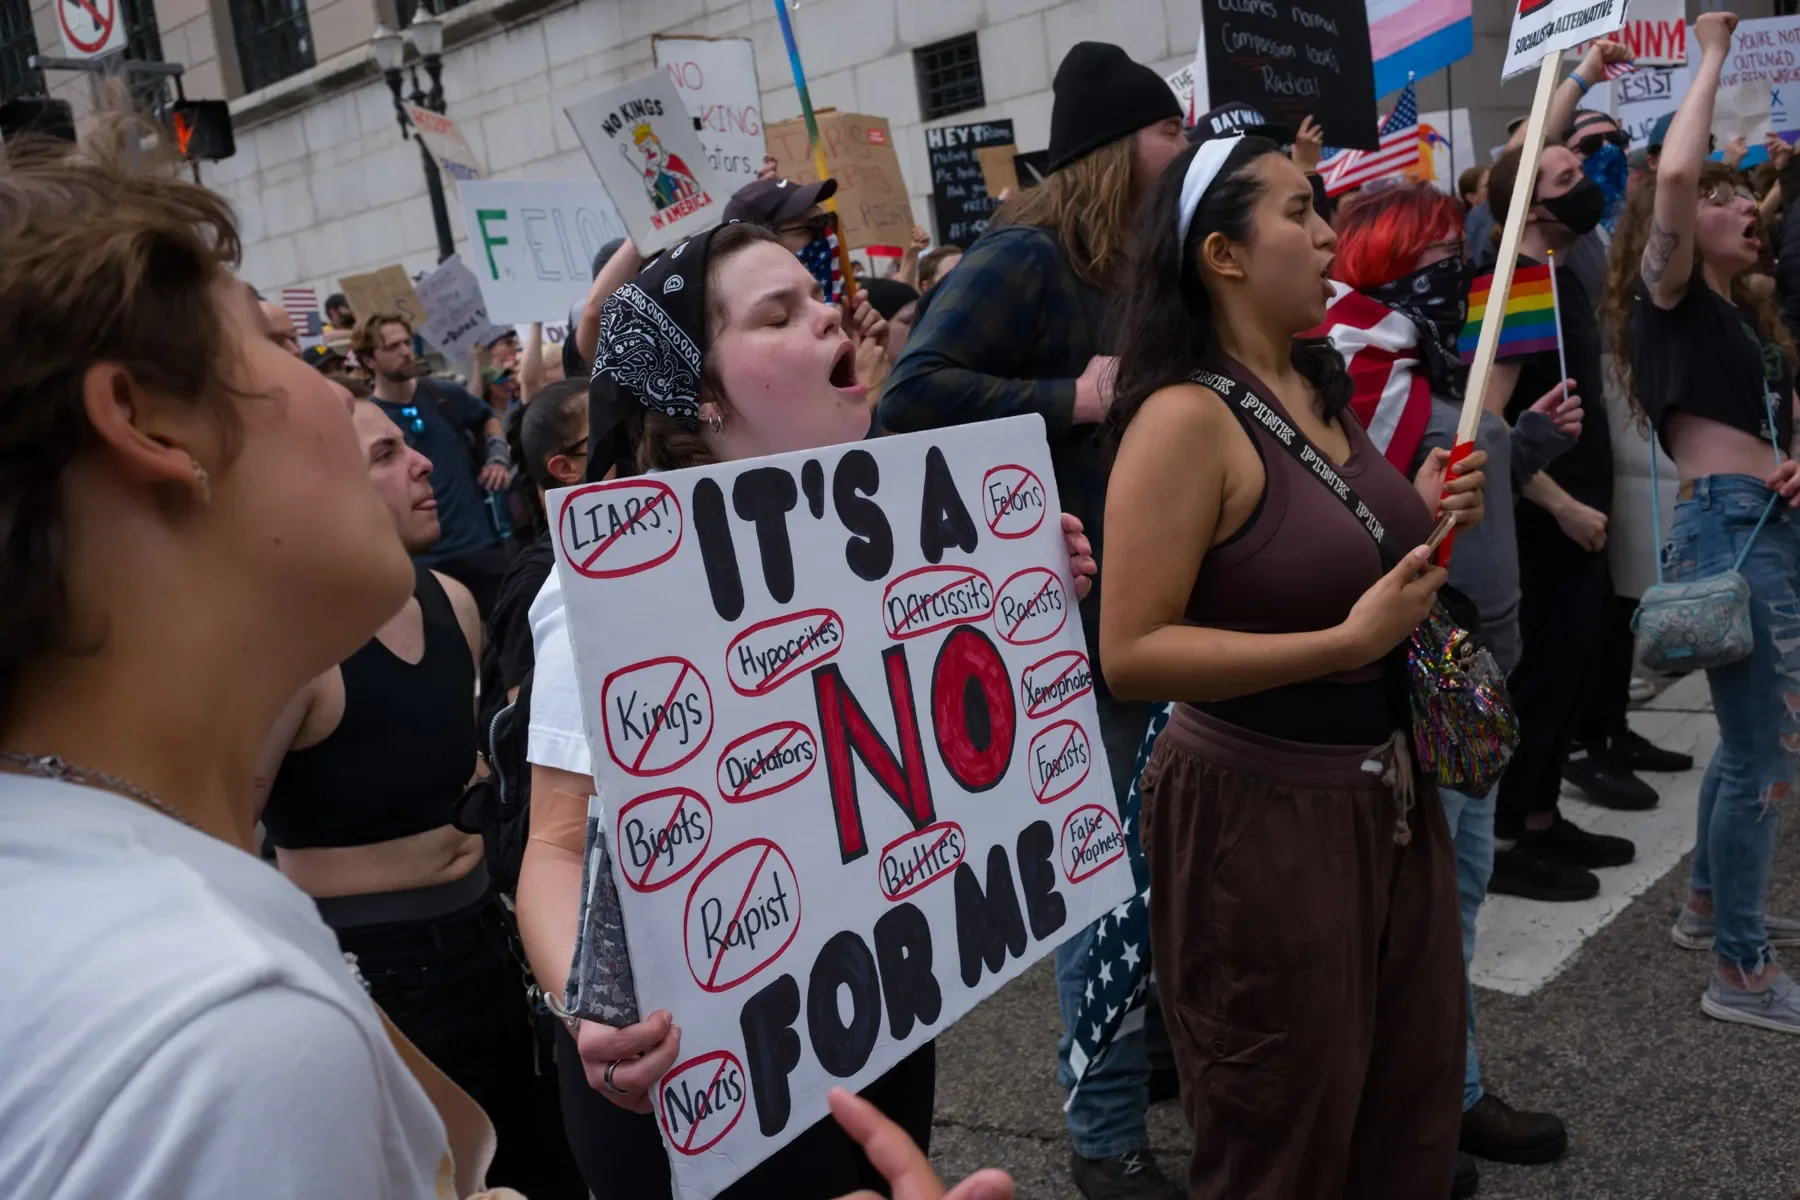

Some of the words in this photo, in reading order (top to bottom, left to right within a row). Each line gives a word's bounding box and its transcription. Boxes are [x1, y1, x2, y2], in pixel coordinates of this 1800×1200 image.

[1554, 0, 1614, 34] ALTERNATIVE
[665, 61, 704, 91] NO
[1262, 64, 1321, 98] Radical
[1618, 71, 1673, 101] ESIST
[601, 112, 622, 139] NO
[619, 98, 665, 124] KINGS
[927, 126, 969, 149] HEY
[650, 214, 666, 231] IN
[665, 191, 713, 225] AMERICA
[1240, 391, 1296, 446] PINK
[1300, 444, 1350, 501] PINK
[568, 495, 673, 551] LIARS!
[989, 482, 1043, 517] Felons
[692, 449, 894, 622] IT'S
[920, 445, 978, 565] A
[1000, 584, 1062, 626] Racists
[737, 621, 839, 678] Hypocrites
[616, 690, 703, 745] Kings
[725, 739, 814, 789] Dictators
[811, 624, 1017, 866] NO
[1036, 735, 1087, 785] Fascists
[624, 807, 705, 867] Bigots
[1070, 815, 1104, 843] False
[1071, 831, 1124, 868] Prophets
[882, 832, 961, 896] Bullies
[700, 870, 790, 959] Rapist
[740, 902, 942, 1138] FOR
[954, 819, 1067, 989] ME
[664, 1069, 743, 1133] Nazis
